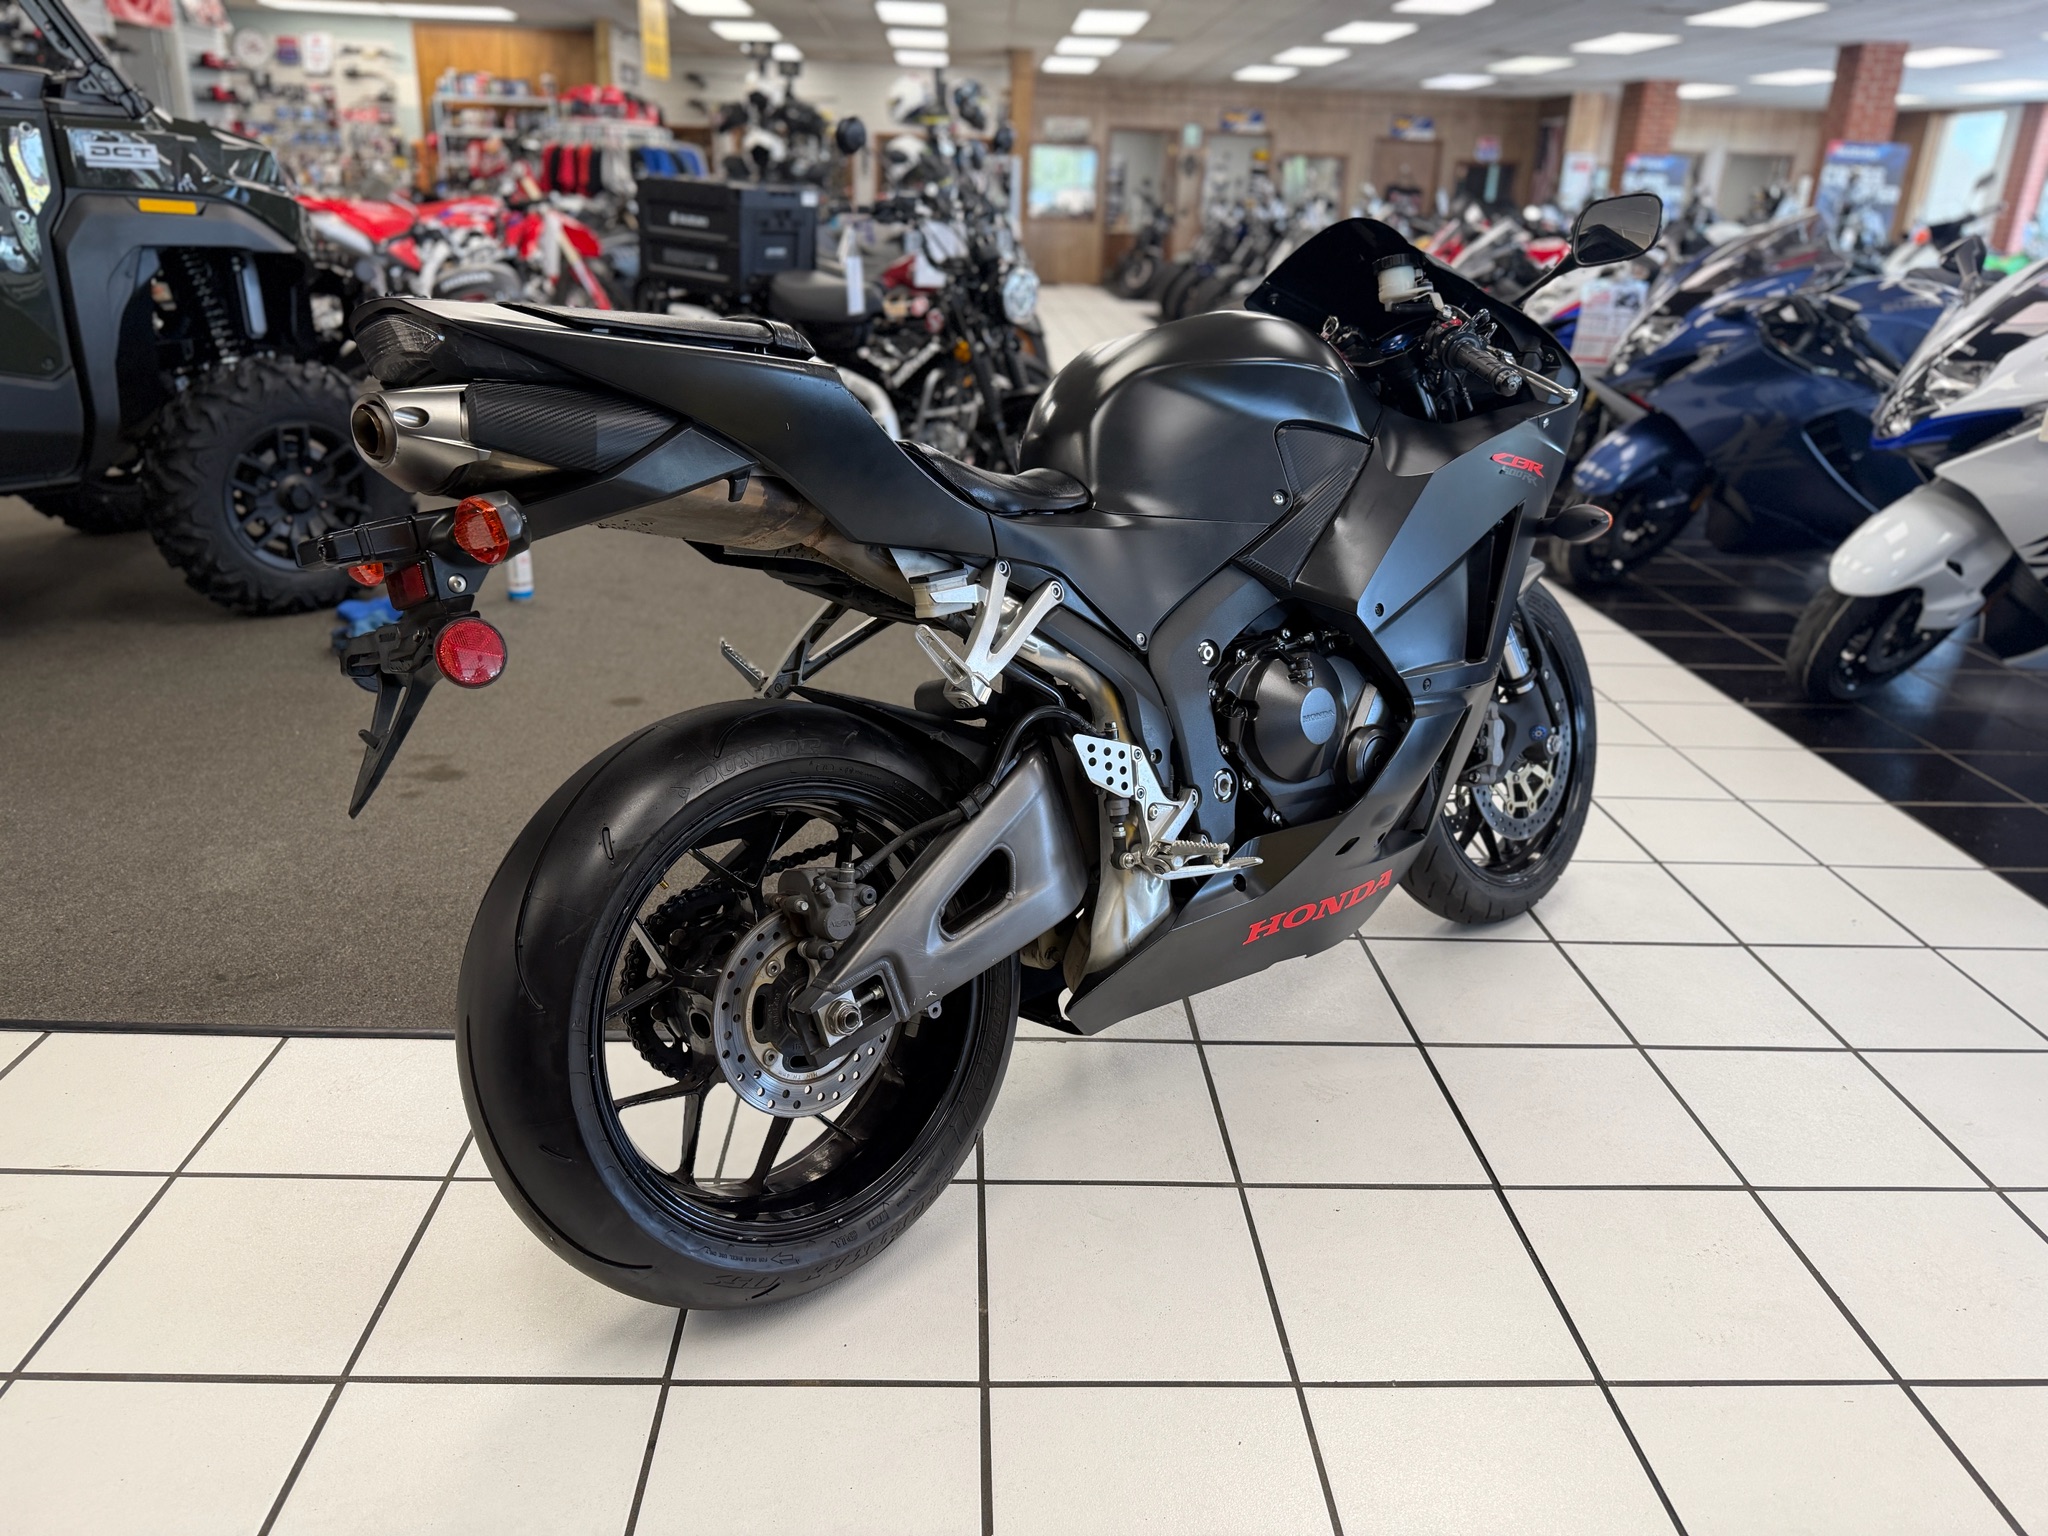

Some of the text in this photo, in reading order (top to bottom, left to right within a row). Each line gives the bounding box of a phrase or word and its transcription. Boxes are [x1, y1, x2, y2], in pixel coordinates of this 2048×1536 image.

[90, 145, 152, 158] DCT
[1490, 452, 1544, 479] CBR
[1302, 709, 1335, 723] HONDA
[694, 737, 824, 790] DUNLOP
[1242, 868, 1394, 946] HONDA
